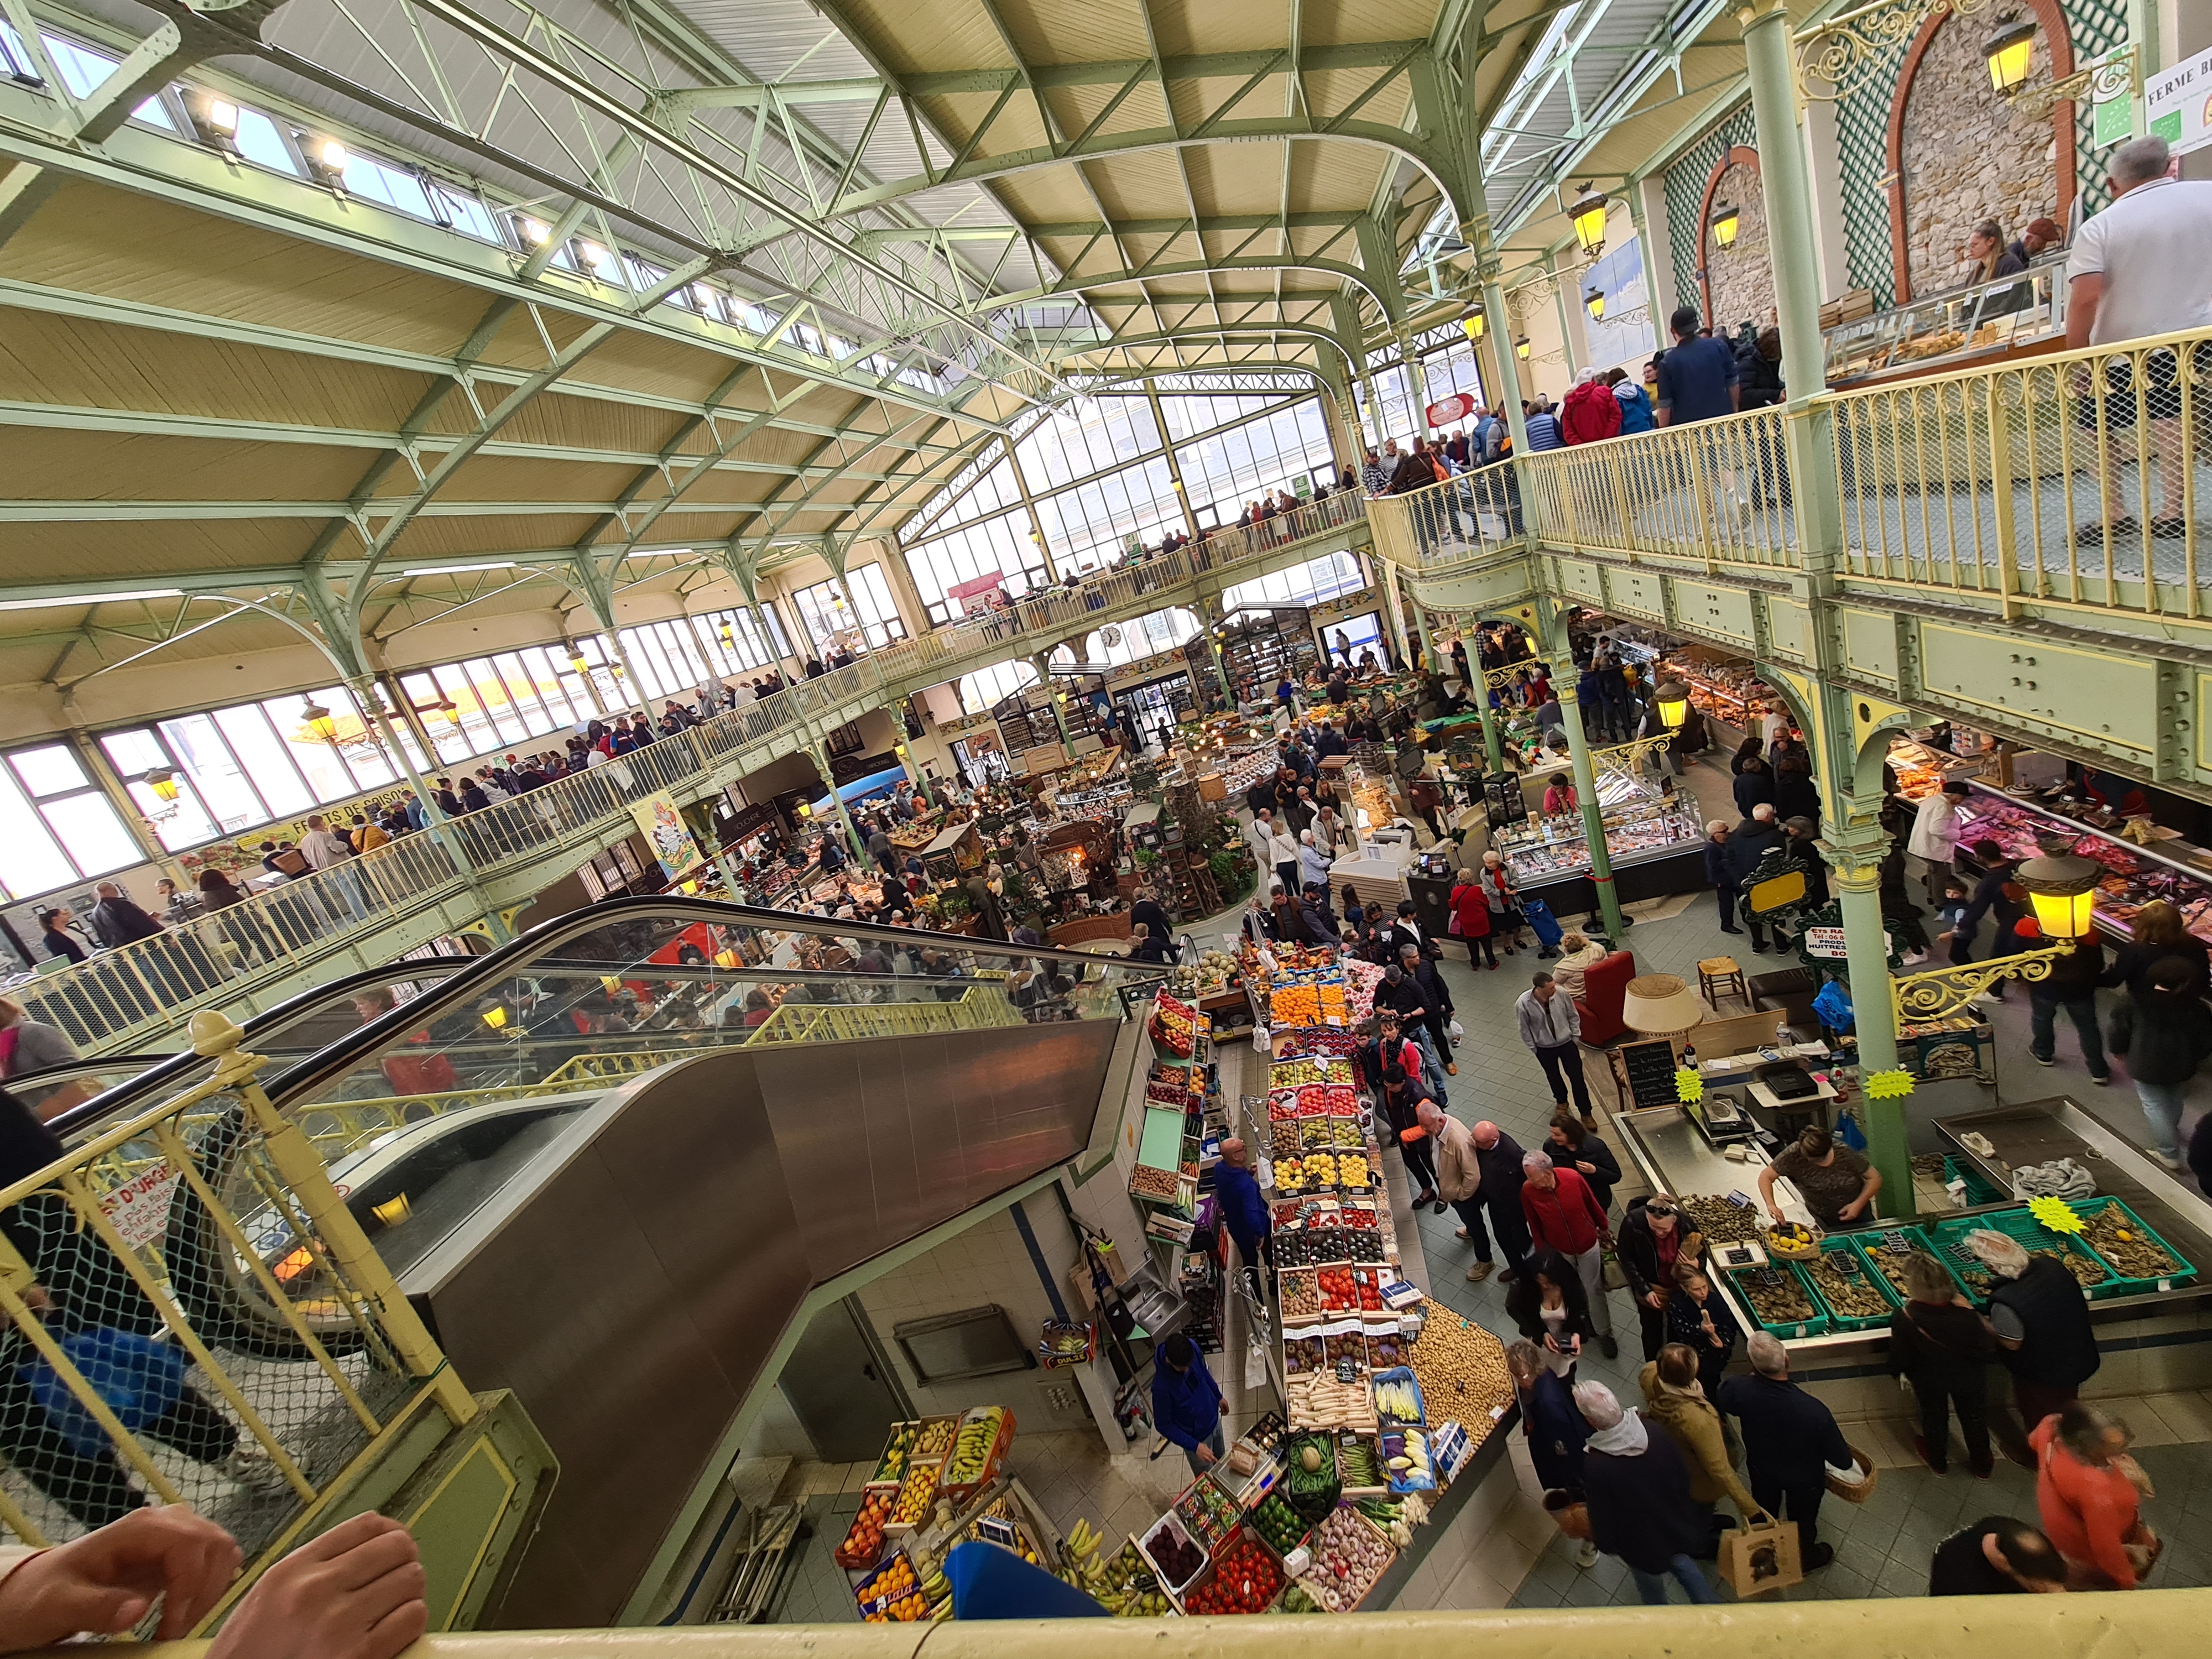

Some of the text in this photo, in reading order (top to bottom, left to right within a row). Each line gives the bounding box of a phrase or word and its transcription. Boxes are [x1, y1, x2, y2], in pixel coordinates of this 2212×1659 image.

[2148, 68, 2194, 106] FERME
[293, 810, 342, 834] FRTS
[344, 804, 362, 817] DE
[122, 1201, 170, 1236] enfants
[124, 1203, 148, 1222] pas
[1057, 1353, 1086, 1364] DULZE
